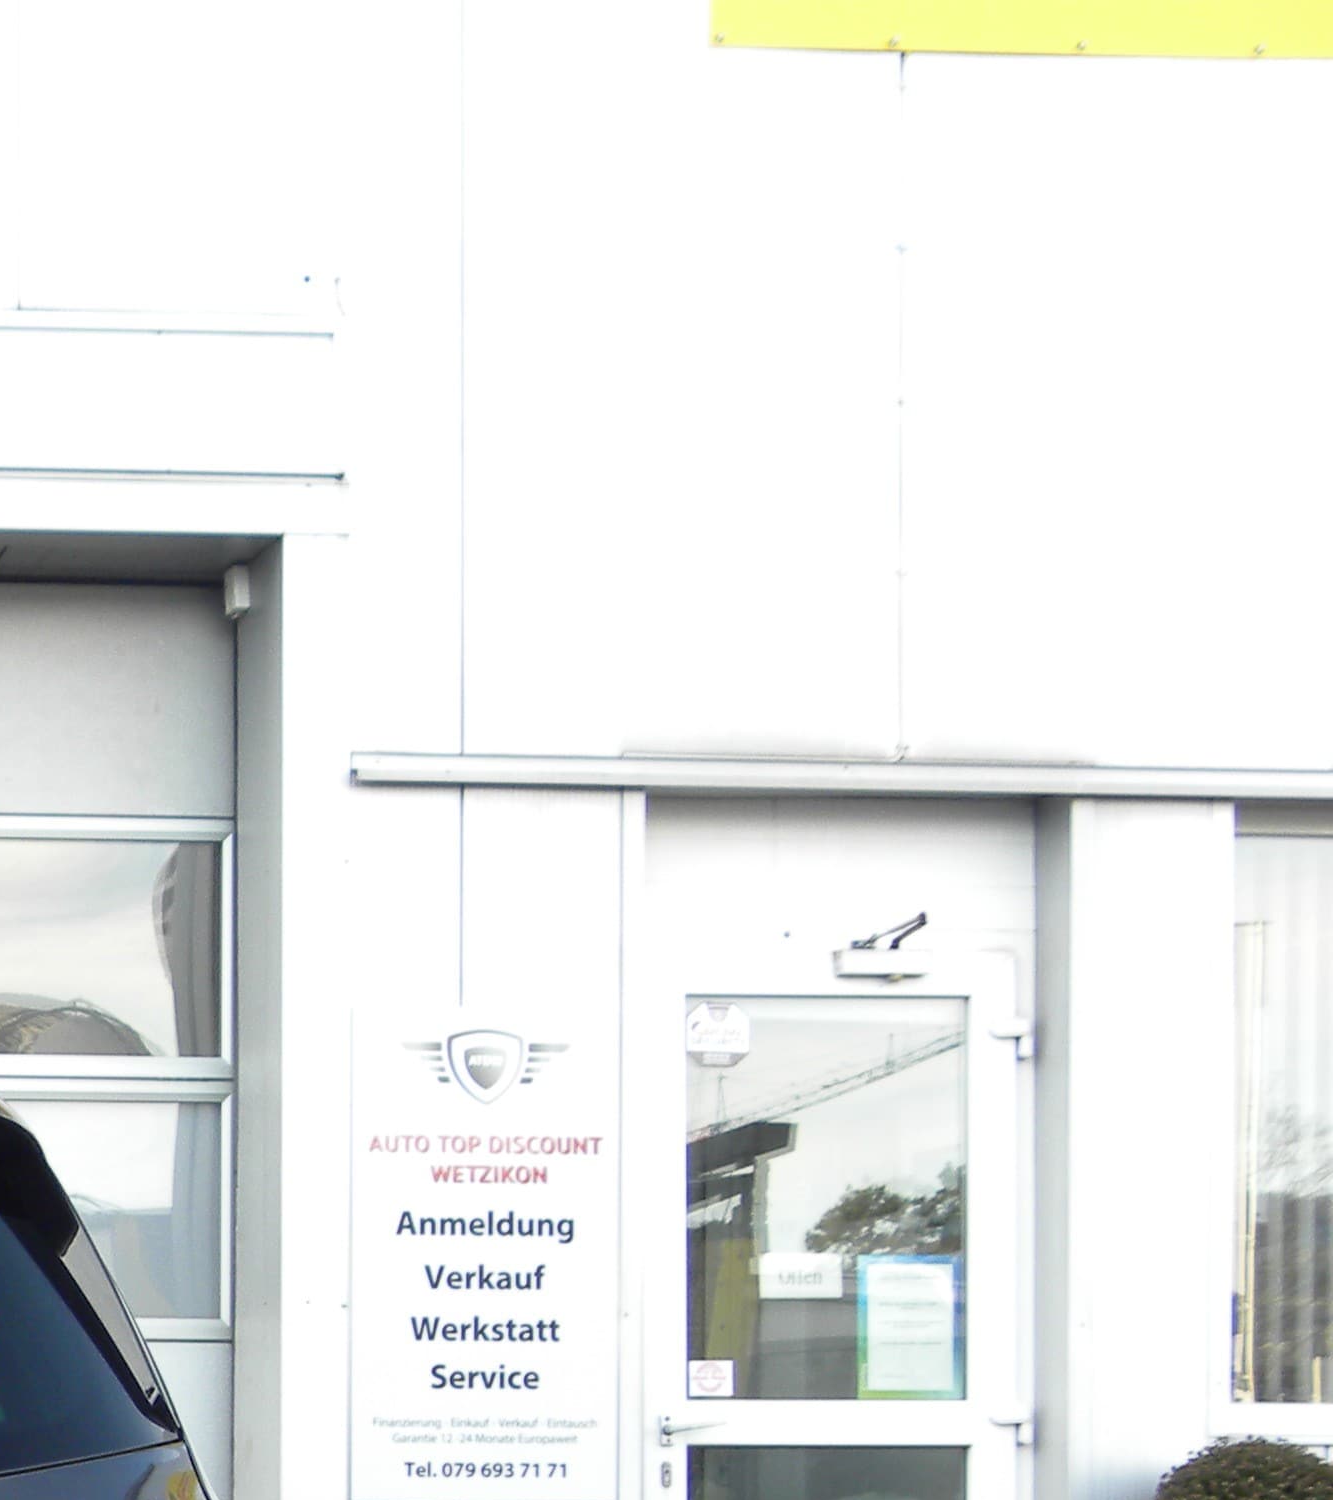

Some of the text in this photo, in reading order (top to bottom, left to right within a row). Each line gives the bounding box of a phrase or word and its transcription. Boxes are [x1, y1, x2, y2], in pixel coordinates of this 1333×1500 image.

[369, 1135, 603, 1155] AUTO TOP DISCOUNT
[431, 1165, 548, 1184] WETZIKON
[396, 1210, 574, 1244] Anmeldung
[424, 1264, 546, 1290] Verkauf
[410, 1315, 560, 1342] Werkstatt
[430, 1364, 539, 1390] Service
[404, 1461, 567, 1478] Tel. 079 693 71 71
